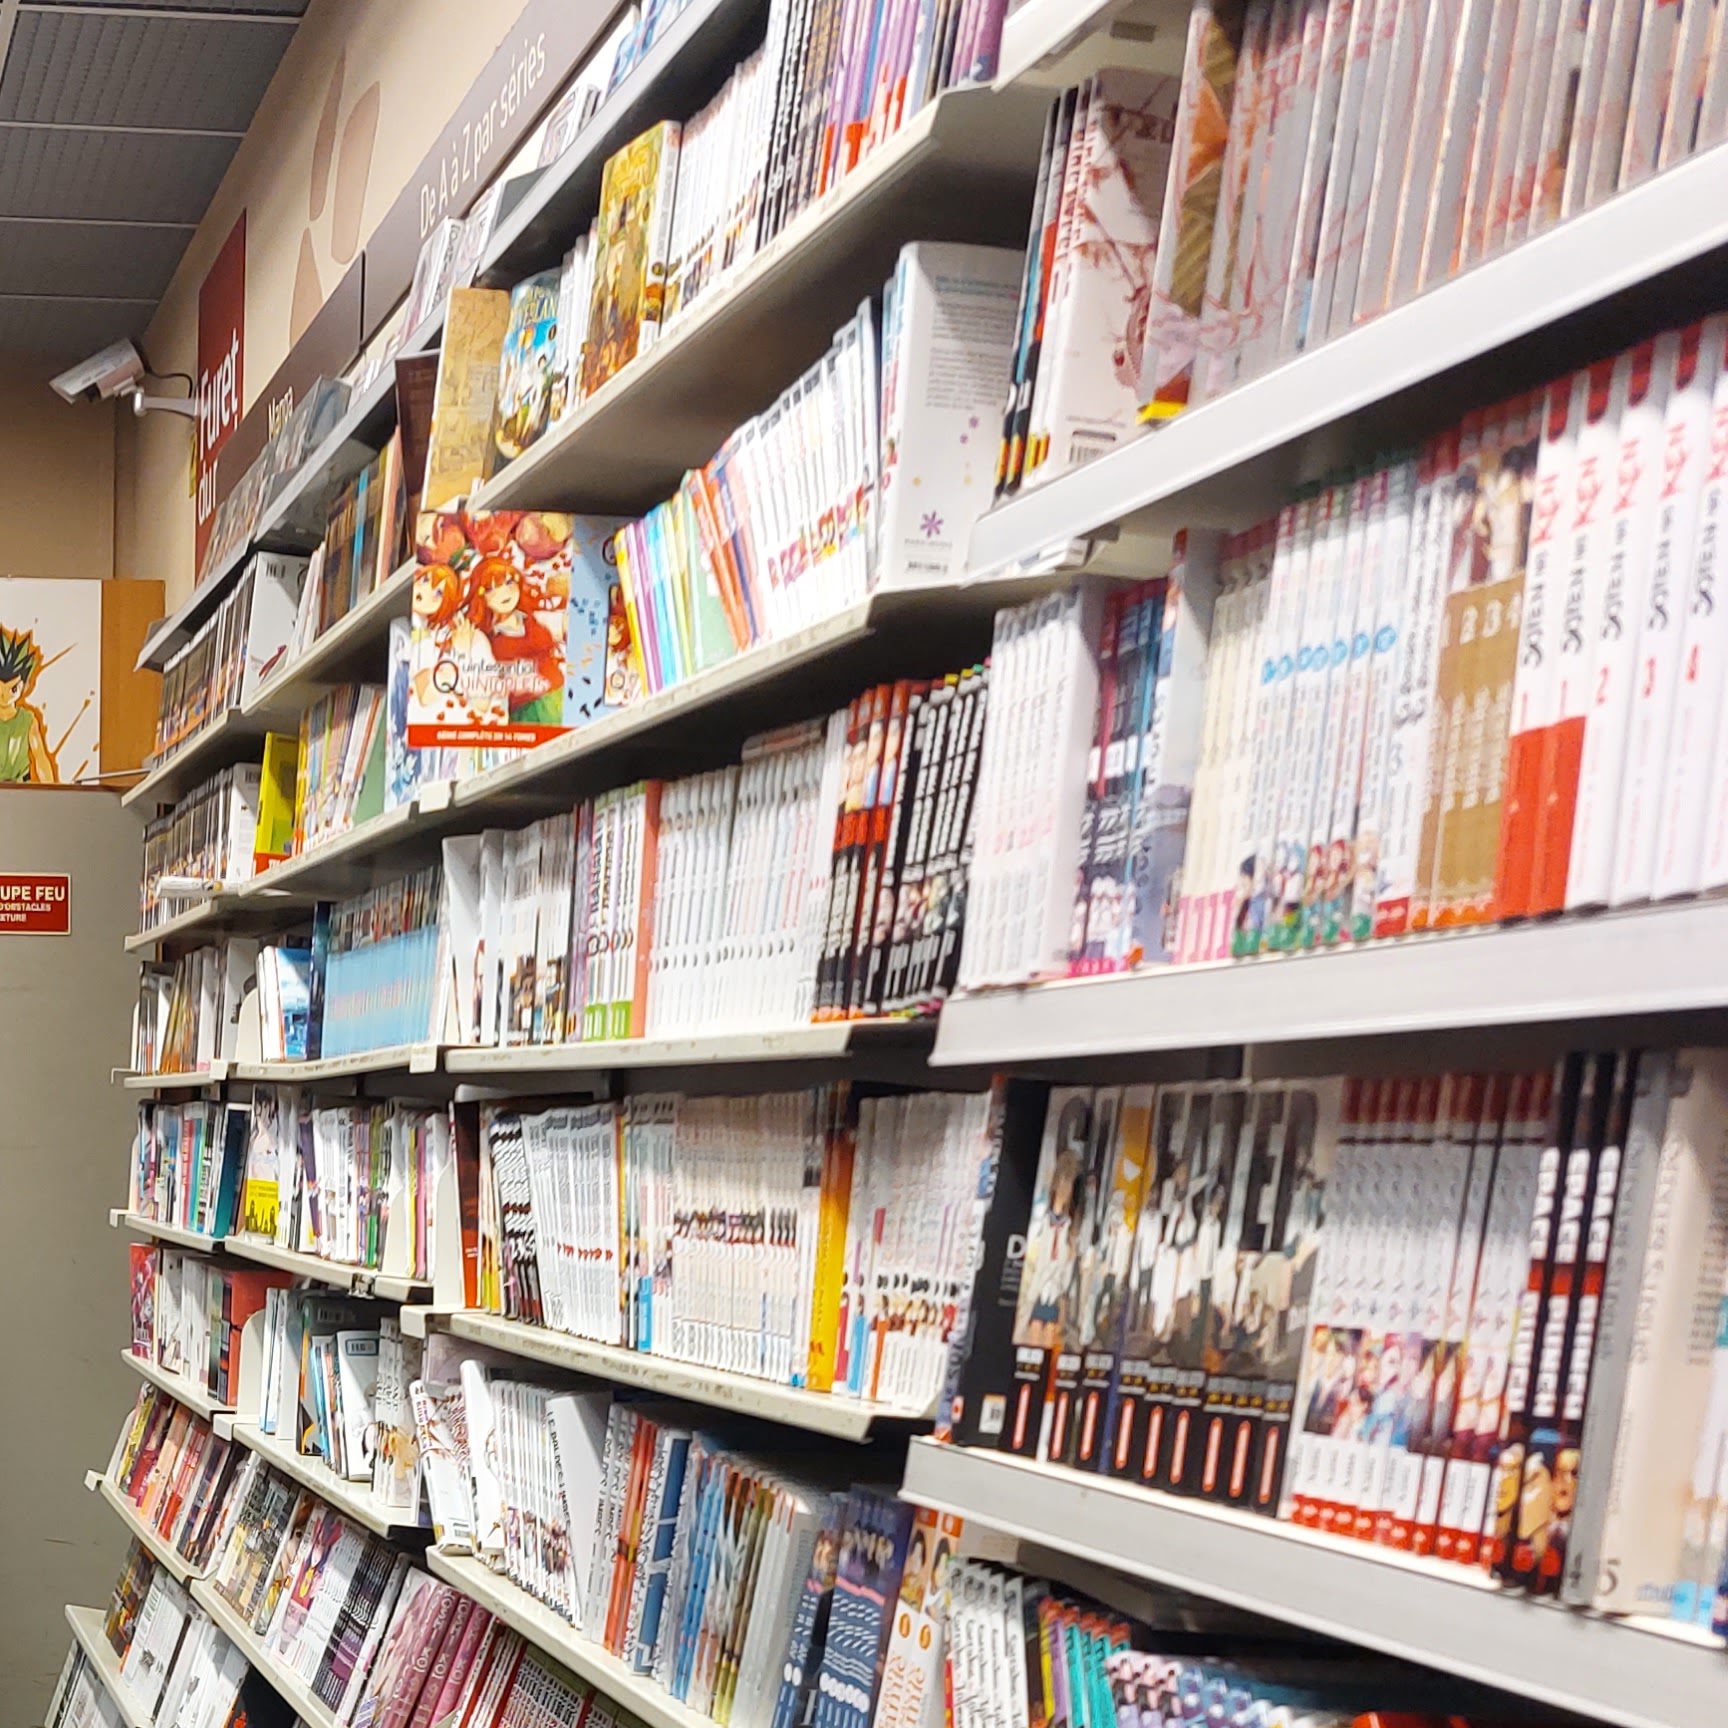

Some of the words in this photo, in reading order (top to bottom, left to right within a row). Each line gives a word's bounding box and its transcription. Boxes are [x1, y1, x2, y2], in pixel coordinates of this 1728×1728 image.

[421, 184, 436, 238] De
[439, 158, 448, 214] A
[451, 141, 459, 193] à
[462, 122, 471, 184] Z
[474, 100, 496, 182] par
[500, 33, 545, 128] séries
[198, 327, 239, 461] Furet
[35, 886, 65, 901] FEU
